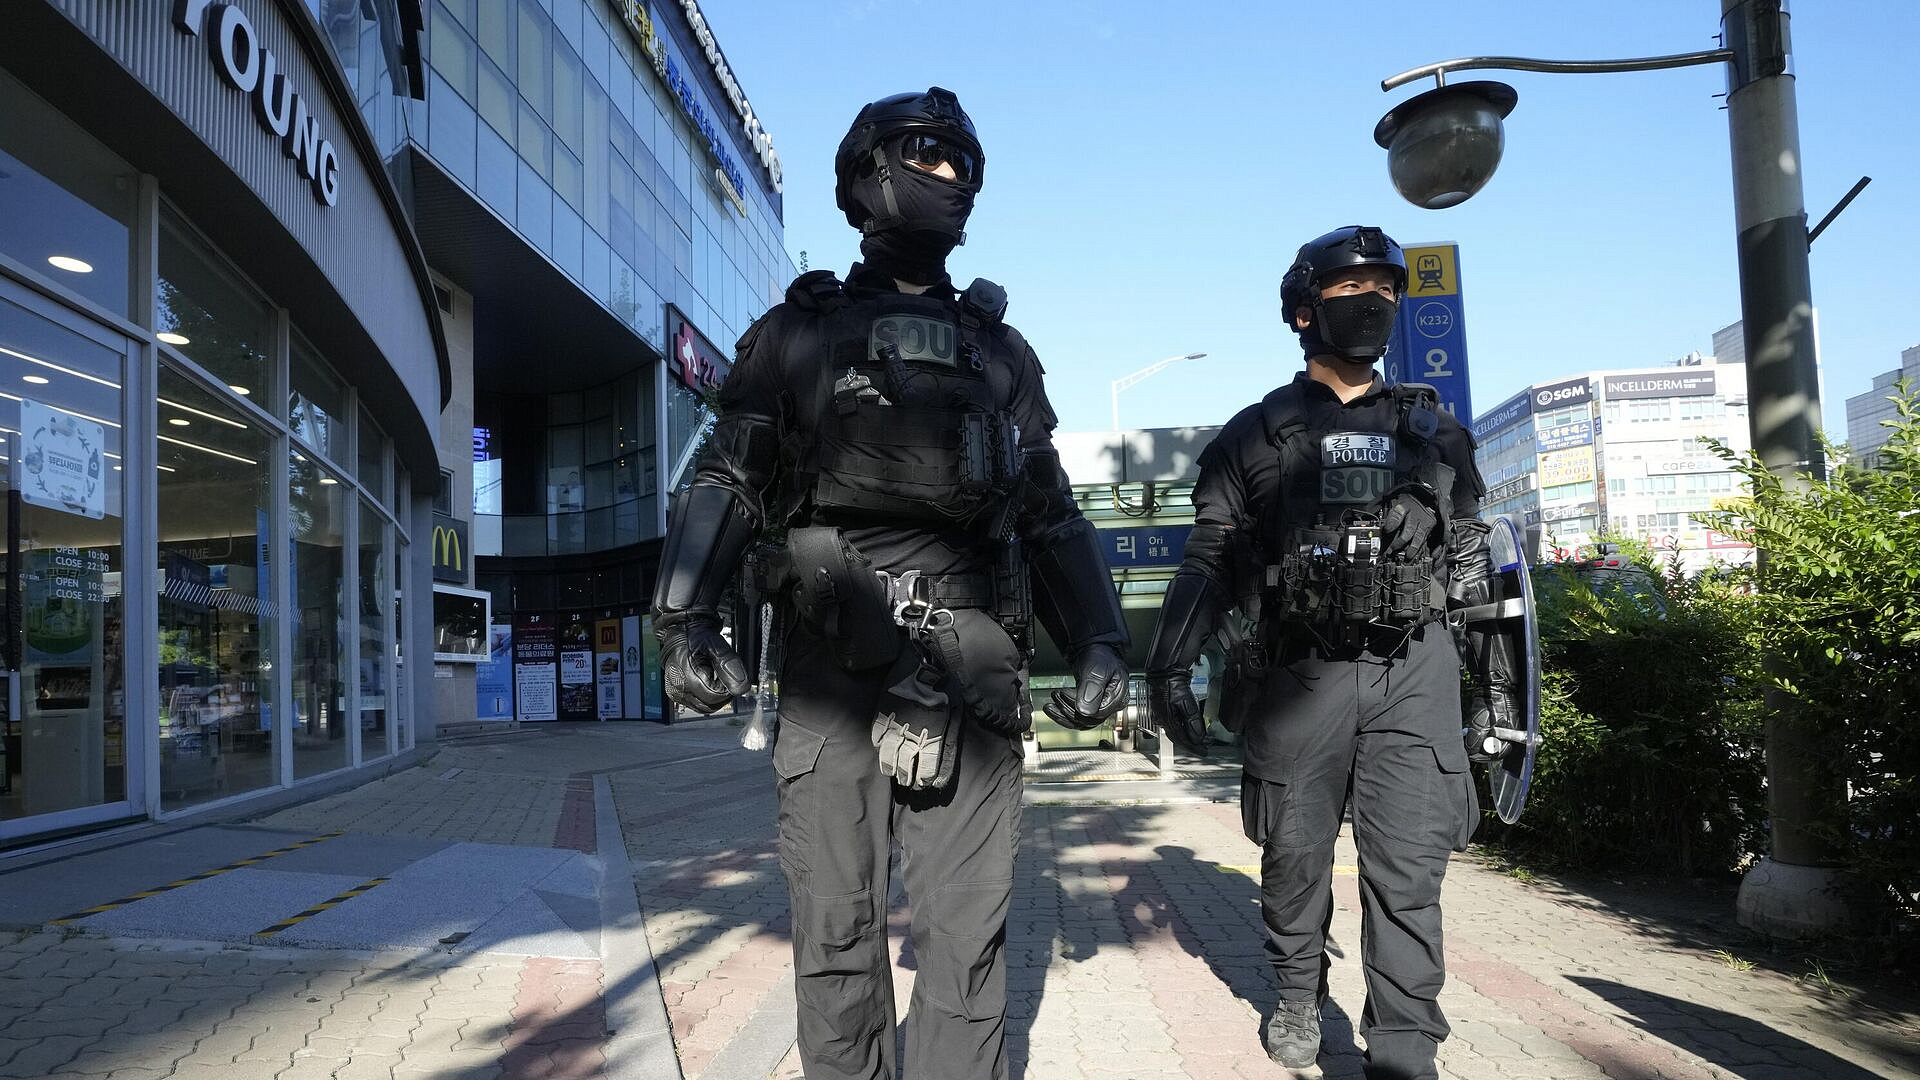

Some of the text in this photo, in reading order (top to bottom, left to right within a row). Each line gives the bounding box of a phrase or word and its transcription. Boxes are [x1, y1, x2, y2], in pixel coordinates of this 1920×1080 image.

[1420, 315, 1449, 326] K232
[874, 320, 953, 359] SOU
[1553, 385, 1585, 401] SGM
[1608, 379, 1683, 393] INCELLDERM
[1472, 410, 1511, 438] NCELLDERM
[1332, 448, 1387, 464] POLICE
[1324, 470, 1390, 498] SOU
[1148, 536, 1163, 545] Ori
[56, 546, 109, 561] OPEN 10:00
[56, 556, 109, 572] CLOSE 22:30
[56, 577, 79, 588] OPEN
[56, 589, 82, 600] CLOSE
